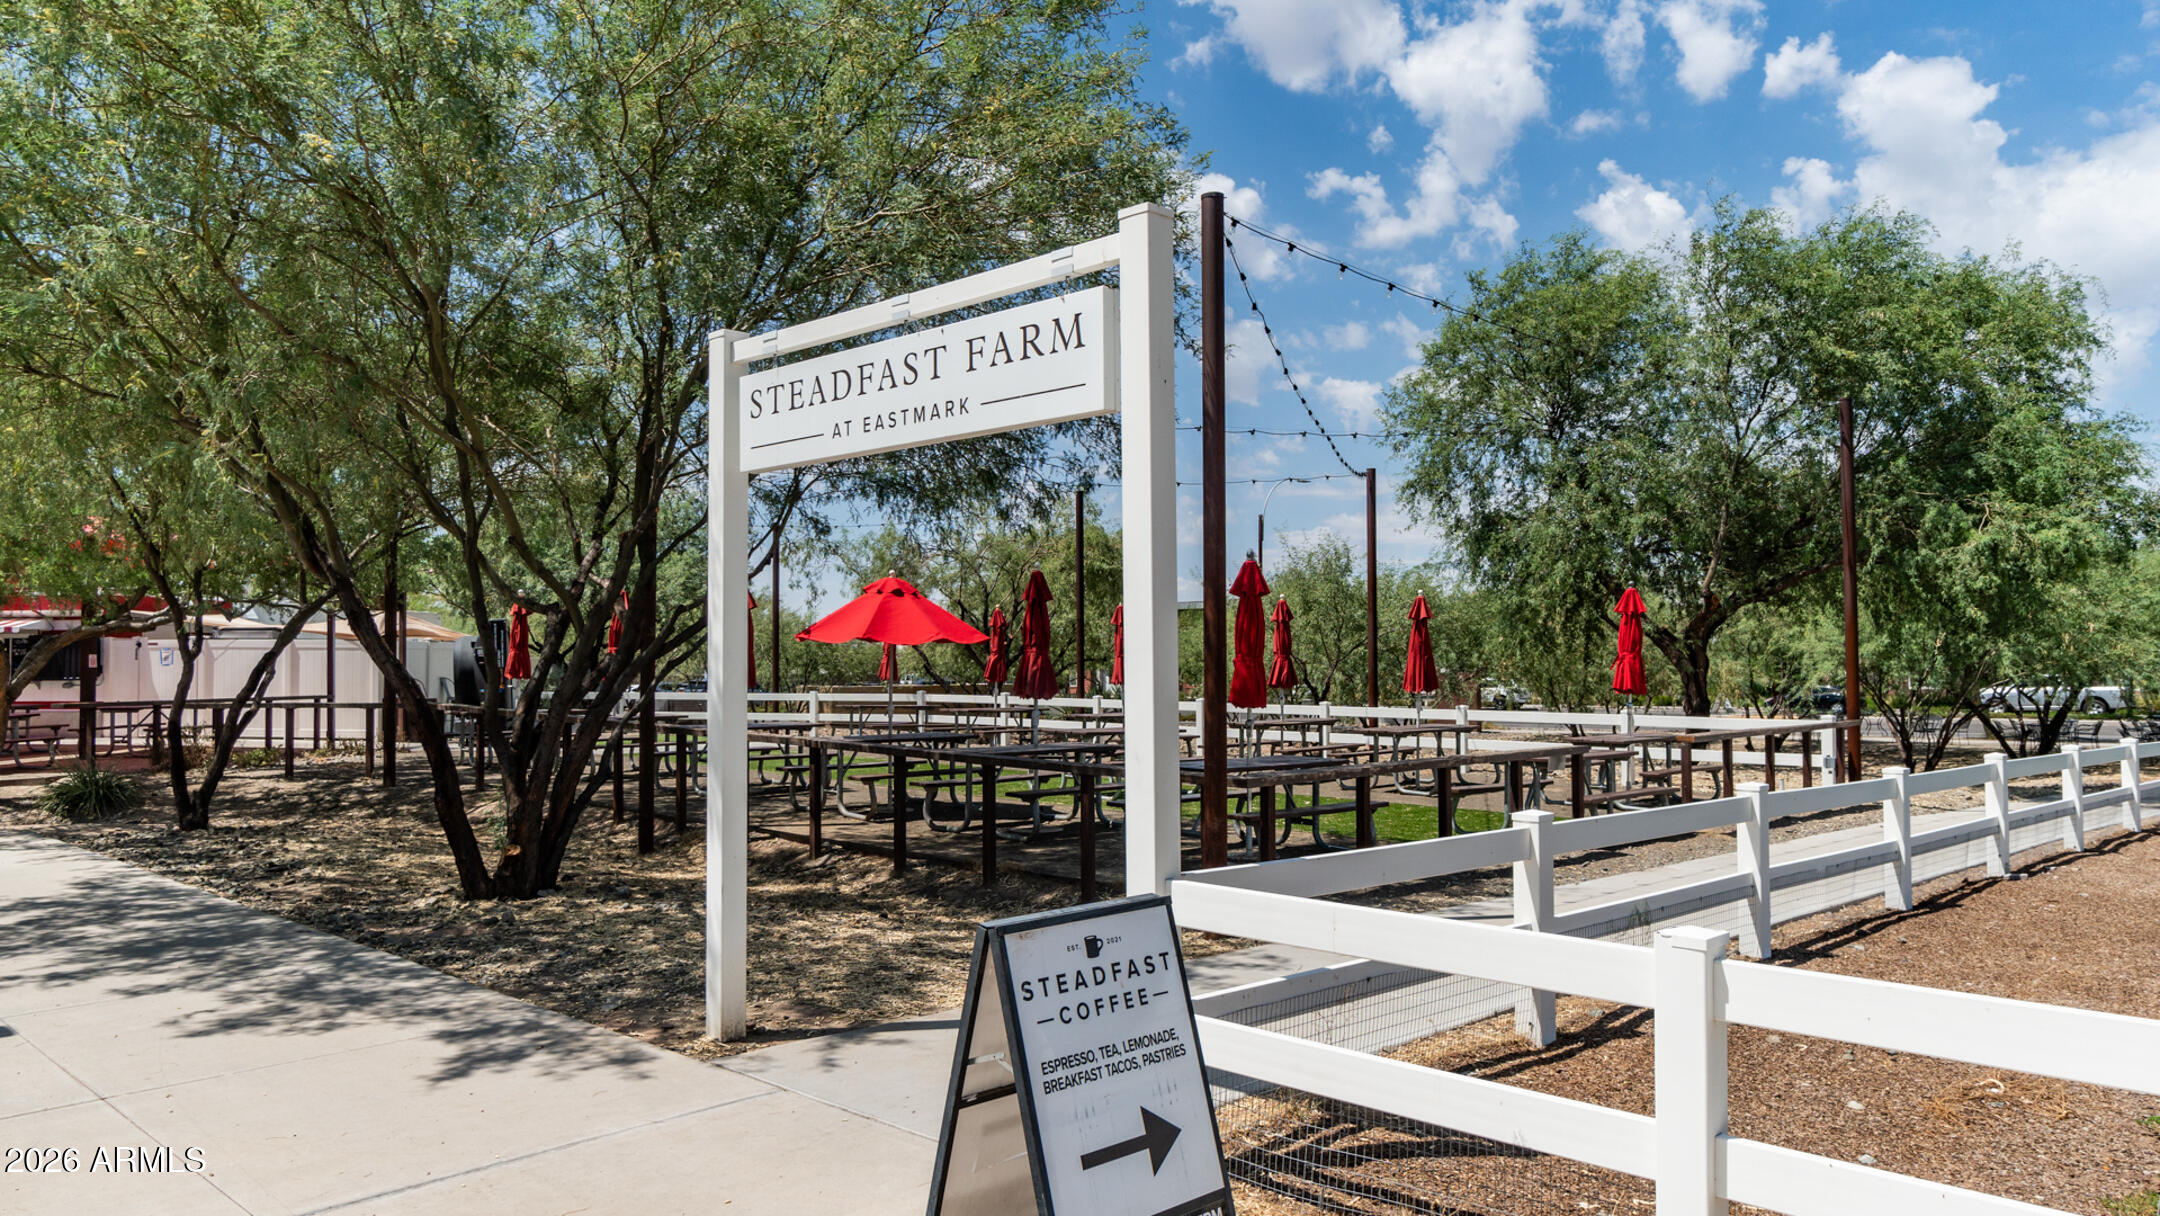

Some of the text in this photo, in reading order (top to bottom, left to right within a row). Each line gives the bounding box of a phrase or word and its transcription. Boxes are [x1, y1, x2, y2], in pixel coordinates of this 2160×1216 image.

[750, 312, 1086, 420] STEADFAST FARM
[832, 397, 970, 439] AT EASTMARK
[1066, 936, 1122, 952] EST. 2021
[1021, 952, 1169, 1002] STEADFAST
[1059, 988, 1149, 1024] COFFEE
[1041, 1028, 1179, 1075] ESPRESSO, TEA, LEMONADE,
[1043, 1043, 1187, 1095] BREAKFAST TACOS, PASTRIES
